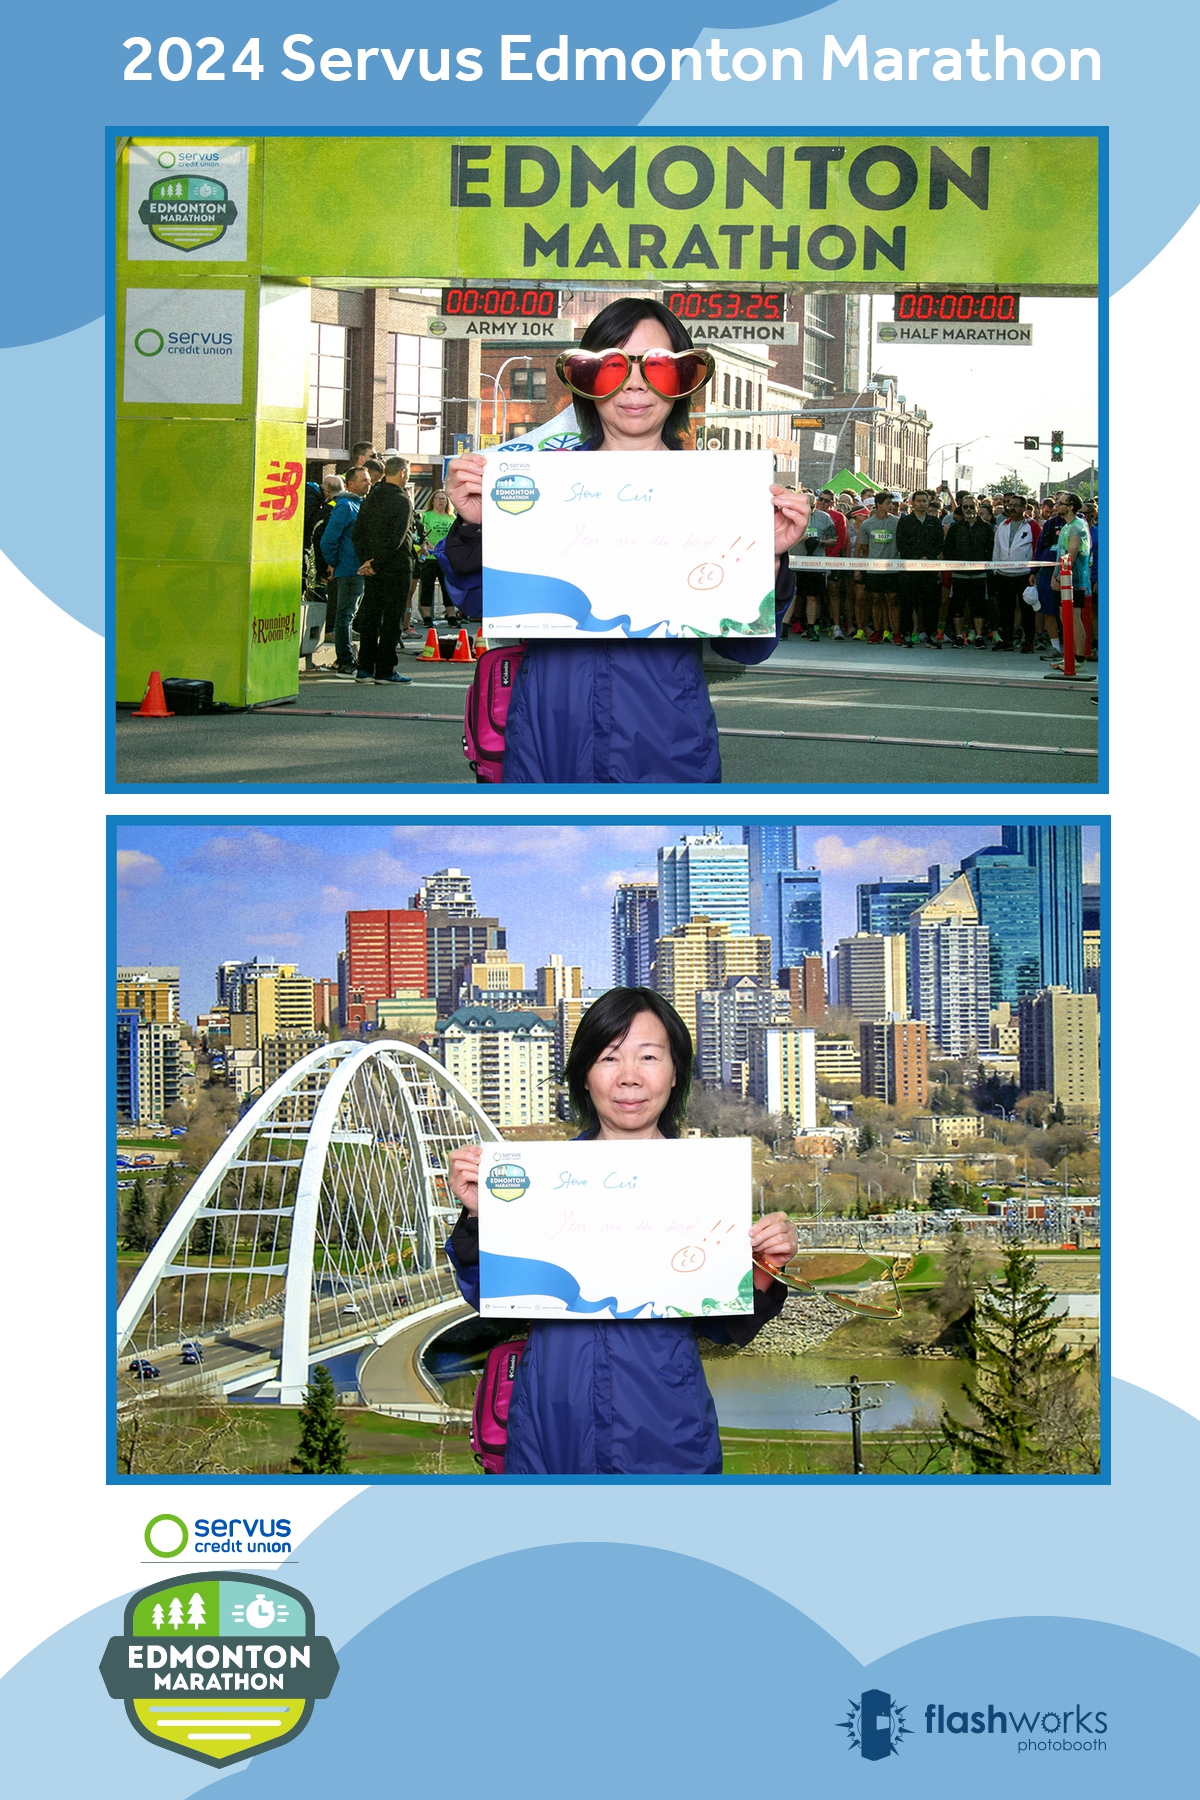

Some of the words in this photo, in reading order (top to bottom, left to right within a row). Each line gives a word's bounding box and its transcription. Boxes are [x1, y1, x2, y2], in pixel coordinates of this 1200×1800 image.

[178, 152, 219, 161] servus
[450, 144, 990, 211] EDMONTON
[149, 203, 227, 213] EDMONTON
[160, 214, 215, 222] MARATHON
[523, 222, 906, 271] MARATHON
[465, 321, 518, 335] ARMY
[522, 322, 554, 336] 10K
[900, 328, 939, 340] HALF
[943, 328, 1031, 341] MARATHON
[168, 332, 233, 345] servus
[167, 345, 200, 354] credit
[202, 347, 233, 355] union
